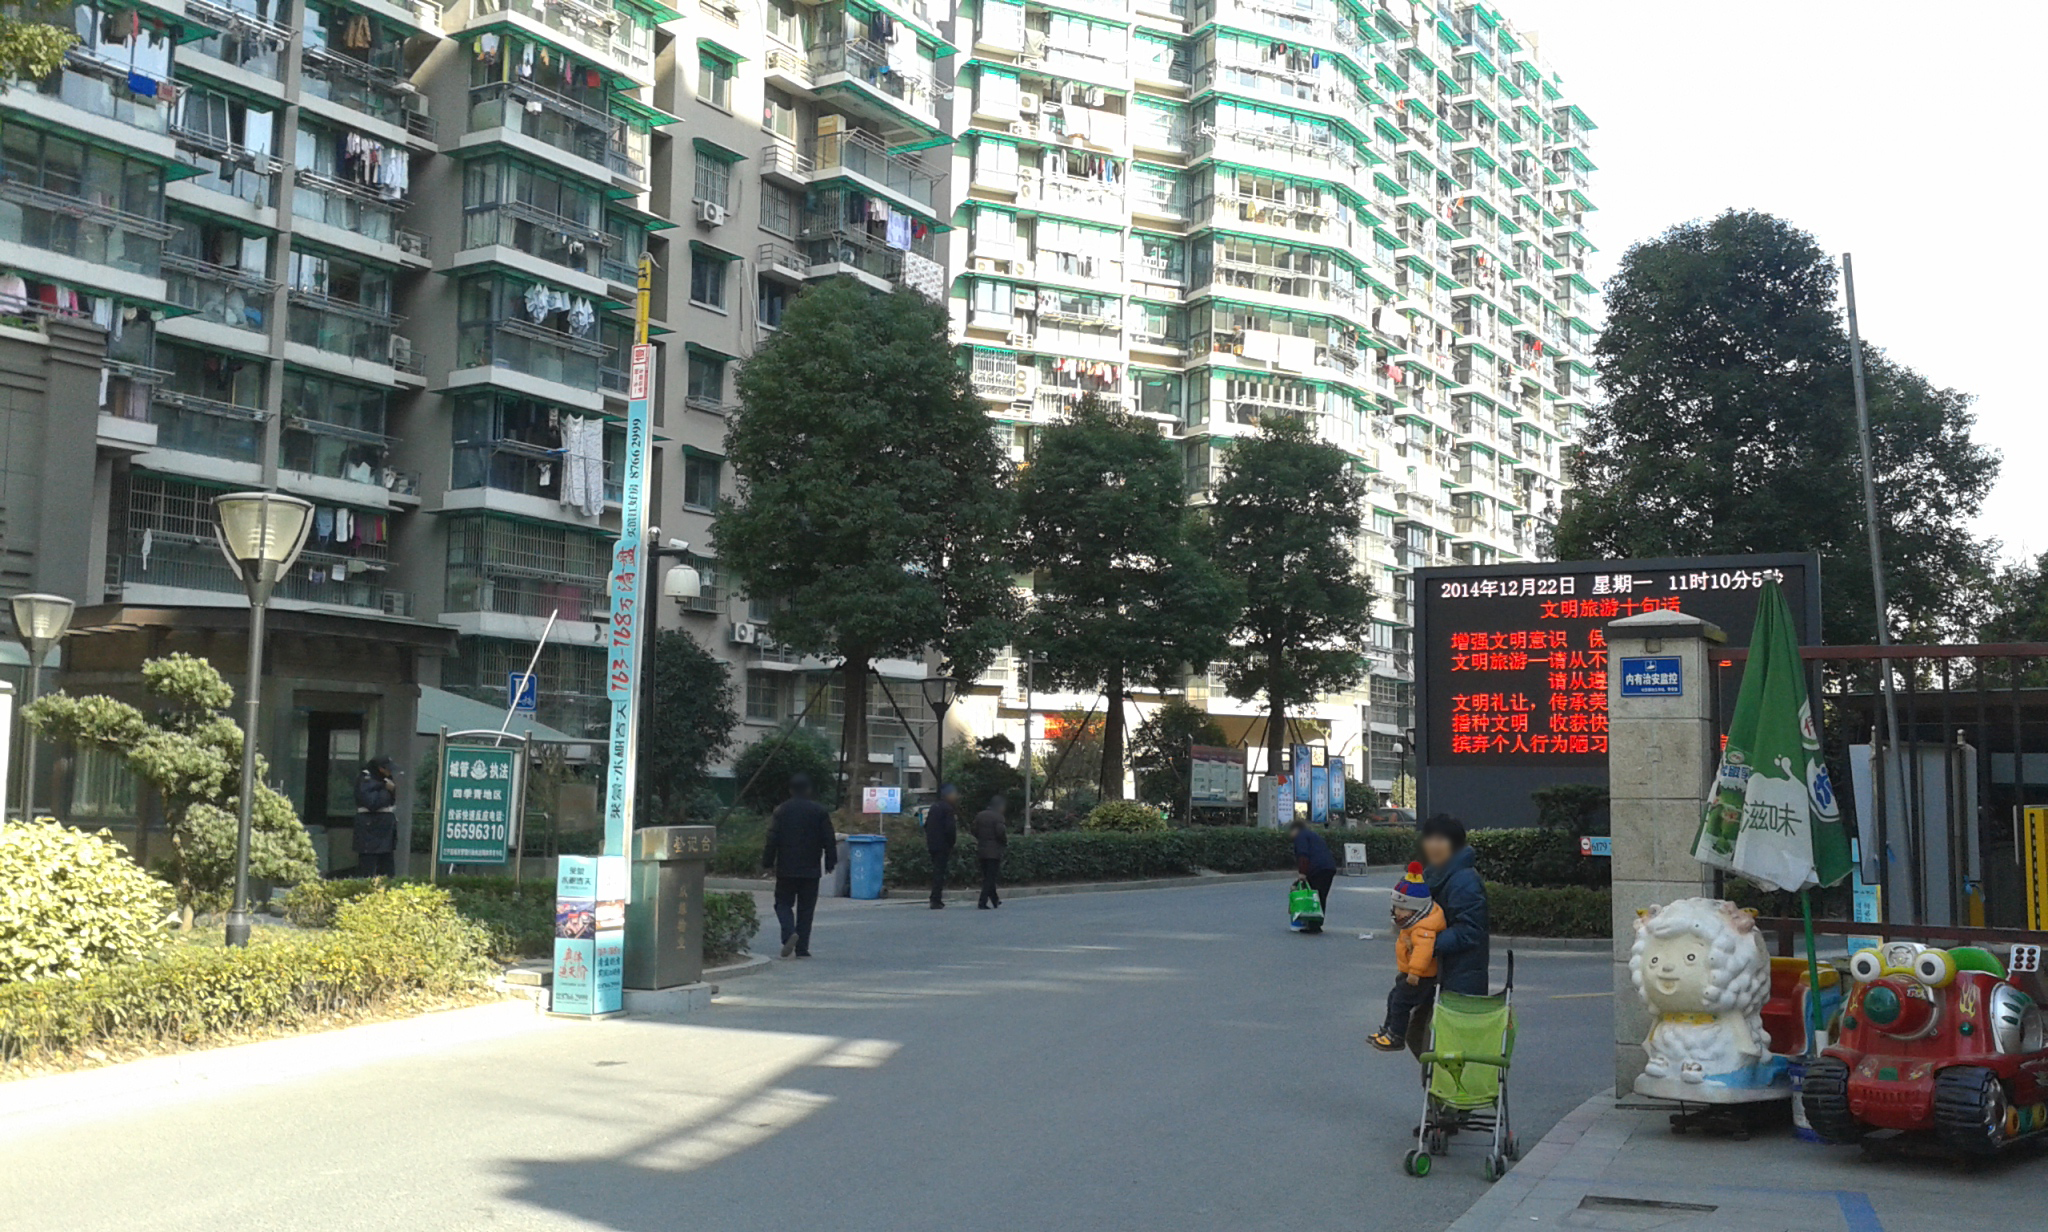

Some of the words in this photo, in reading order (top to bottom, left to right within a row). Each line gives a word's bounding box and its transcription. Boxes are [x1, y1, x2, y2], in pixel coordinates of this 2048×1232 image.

[633, 418, 642, 447] 2999
[1441, 577, 1576, 598] 2014年12月22日
[1592, 574, 1654, 595] 星期一
[1540, 596, 1681, 619] 文明旅游十句话
[1451, 631, 1568, 651] 增强文明意识
[1588, 628, 1608, 648] 保
[1548, 671, 1608, 691] 请从遵
[1626, 672, 1678, 686] 内有治安监控
[1452, 713, 1528, 733] 播种文明
[1549, 713, 1609, 732] 收获快
[450, 760, 470, 779] 城管
[489, 762, 509, 780] 执法
[452, 788, 503, 801] 四季青地区
[1741, 800, 1802, 837] 滋味
[446, 823, 504, 840] 56596310
[672, 835, 712, 854] 登记台
